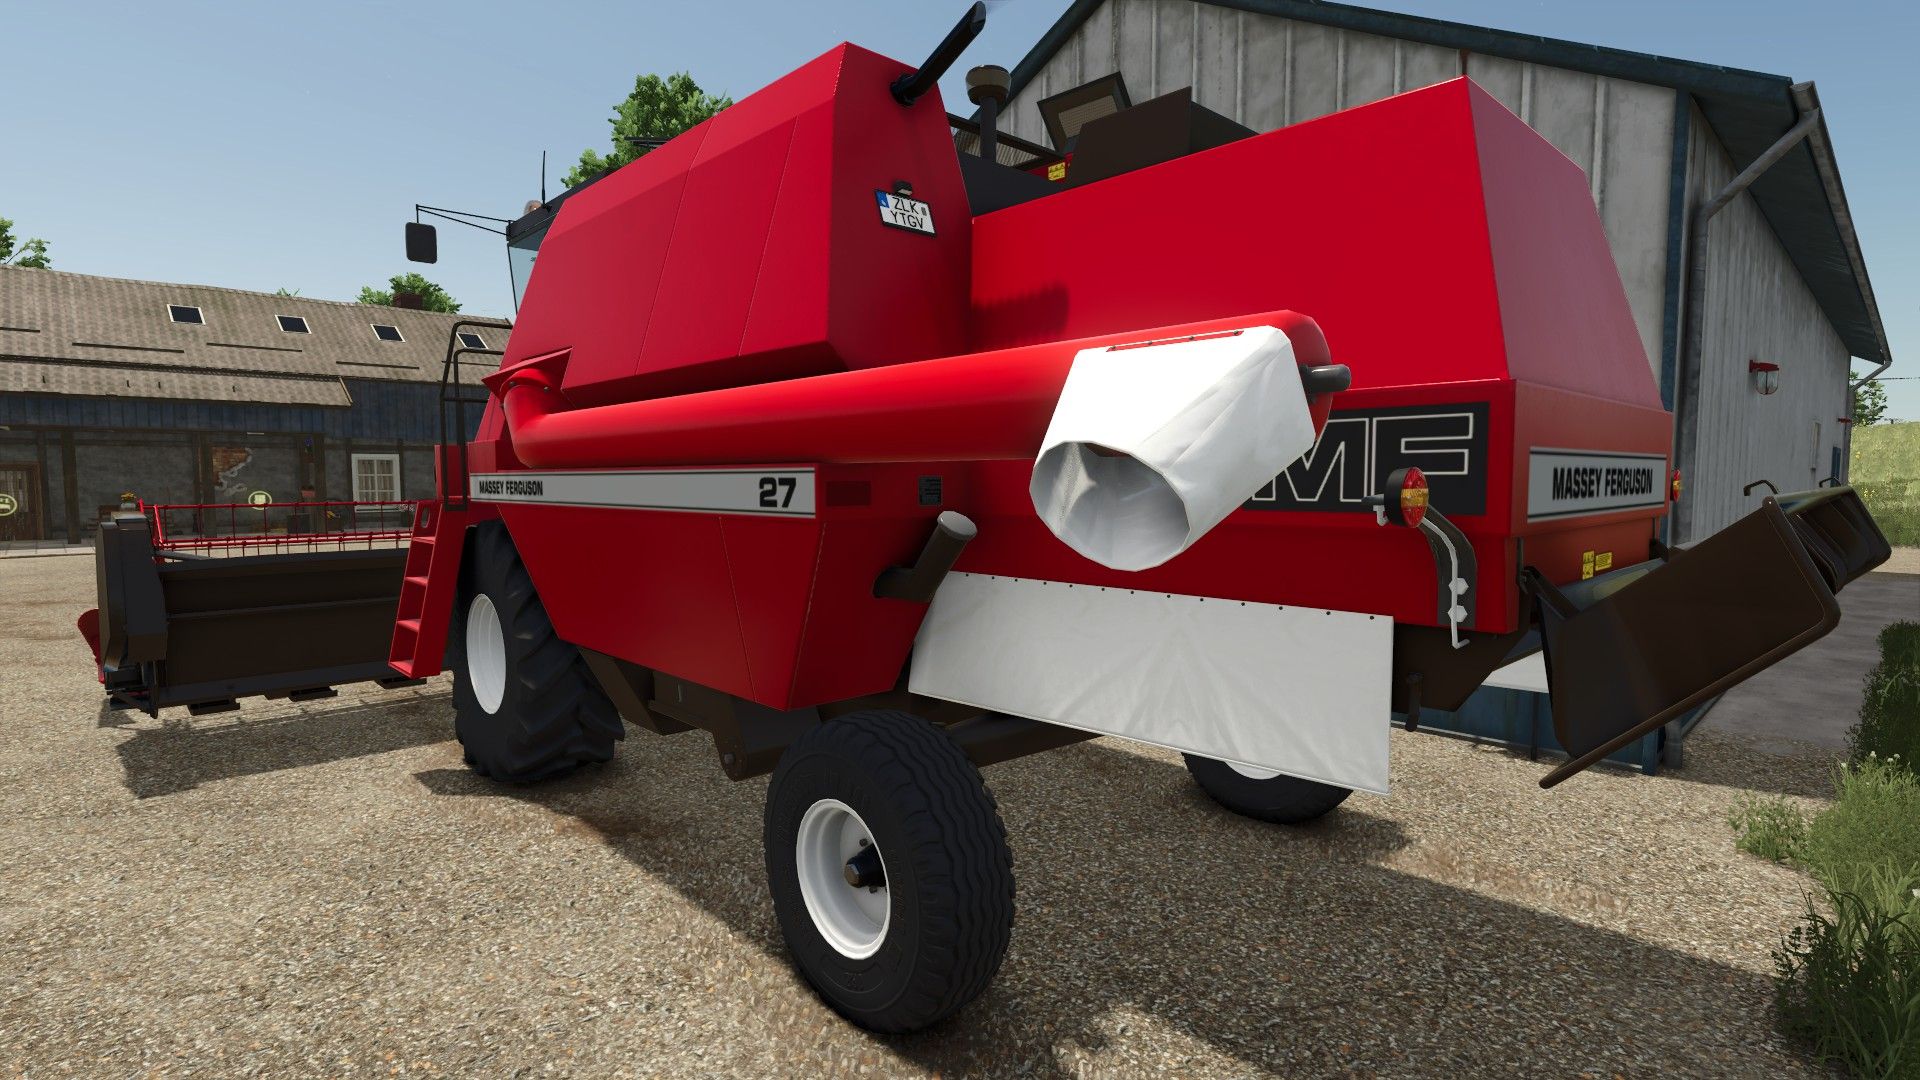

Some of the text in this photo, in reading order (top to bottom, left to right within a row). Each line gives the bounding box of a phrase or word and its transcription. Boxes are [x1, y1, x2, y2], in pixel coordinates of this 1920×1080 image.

[892, 197, 918, 214] ZLK
[890, 211, 923, 228] YTGV
[479, 477, 797, 508] MASSEY FERGUSON 27
[1552, 467, 1653, 501] MASSEY FERGUSON
